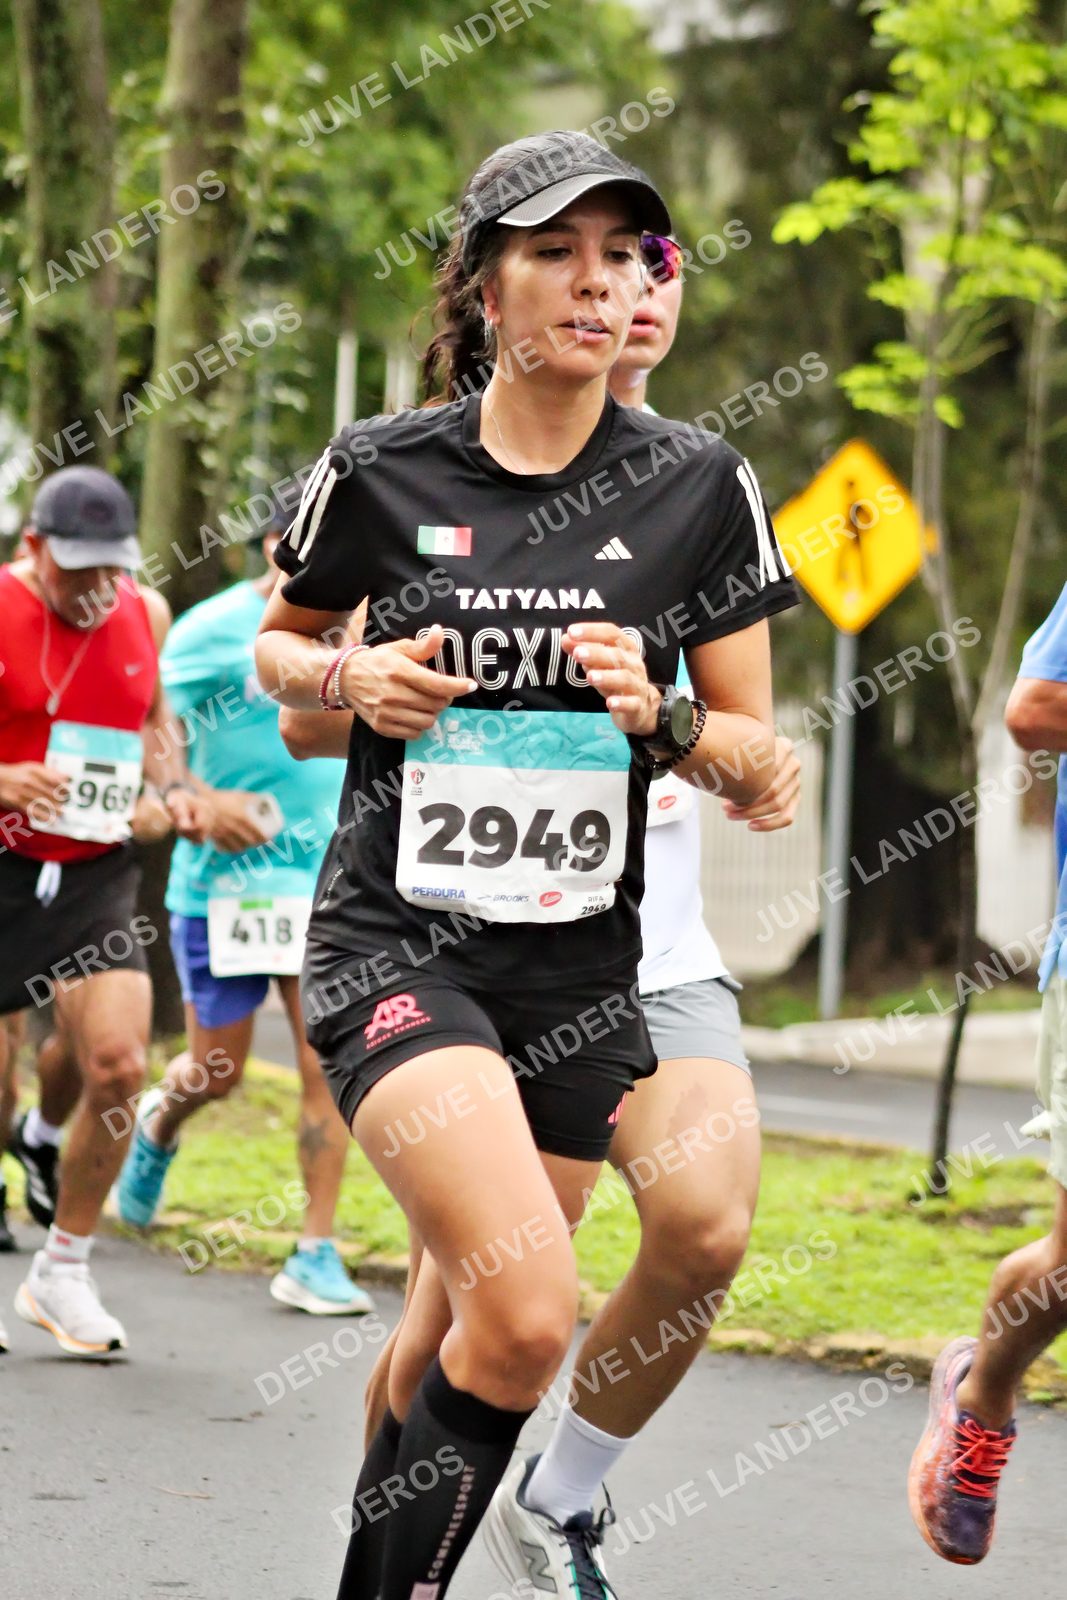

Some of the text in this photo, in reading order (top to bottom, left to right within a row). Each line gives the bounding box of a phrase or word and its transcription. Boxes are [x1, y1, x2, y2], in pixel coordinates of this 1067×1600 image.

[455, 588, 605, 610] TATYANA
[416, 627, 643, 691] MEXI
[416, 802, 611, 872] 2949
[411, 886, 466, 900] PERDURA
[492, 894, 530, 903] BROOKS
[230, 916, 293, 945] 418
